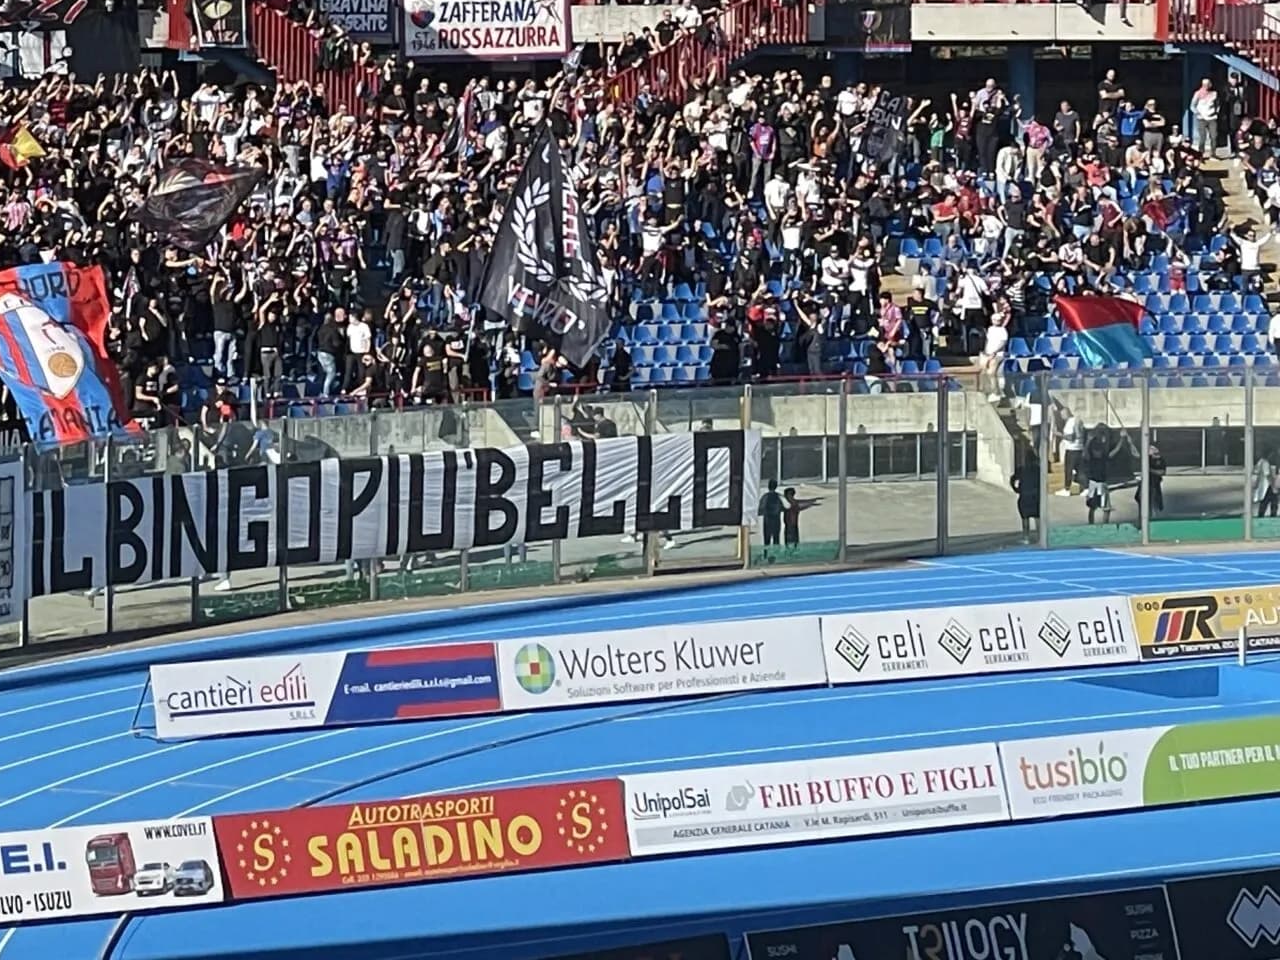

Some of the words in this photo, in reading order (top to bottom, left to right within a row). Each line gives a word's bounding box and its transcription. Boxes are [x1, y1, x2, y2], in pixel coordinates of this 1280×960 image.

[438, 24, 560, 50] ROSSAZZURRA
[32, 490, 92, 596] IL
[107, 462, 322, 585] BINGO
[473, 428, 745, 548] BELLO
[877, 619, 926, 659] celi
[979, 613, 1027, 652] celi
[1078, 607, 1124, 645] celi
[558, 644, 667, 679] Wolters
[673, 638, 765, 671] Kluwer
[167, 679, 254, 711] cantieri
[260, 676, 308, 704] edili
[567, 685, 611, 699] Soluzioni
[613, 681, 657, 695] Software
[658, 682, 673, 693] per
[676, 674, 740, 689] Professionisti
[750, 670, 786, 683] Aziende
[1182, 752, 1200, 771] TUO
[1200, 748, 1244, 768] PARTNER
[1245, 746, 1266, 764] PER
[633, 787, 711, 818] UnipolSai
[759, 783, 801, 809] F.lli
[807, 773, 895, 806] BUFFO
[900, 771, 919, 796] E
[922, 765, 997, 794] FIGLI
[348, 796, 494, 827] AUTOTRASPORTI
[572, 803, 593, 839] S
[673, 826, 710, 838] AGENZIA
[710, 824, 753, 836] GENERALE
[754, 820, 791, 831] CATANIA
[252, 834, 276, 872] S
[307, 814, 543, 878] SALADINO
[34, 890, 72, 912] ISUZU
[1130, 928, 1159, 939] PIZZA
